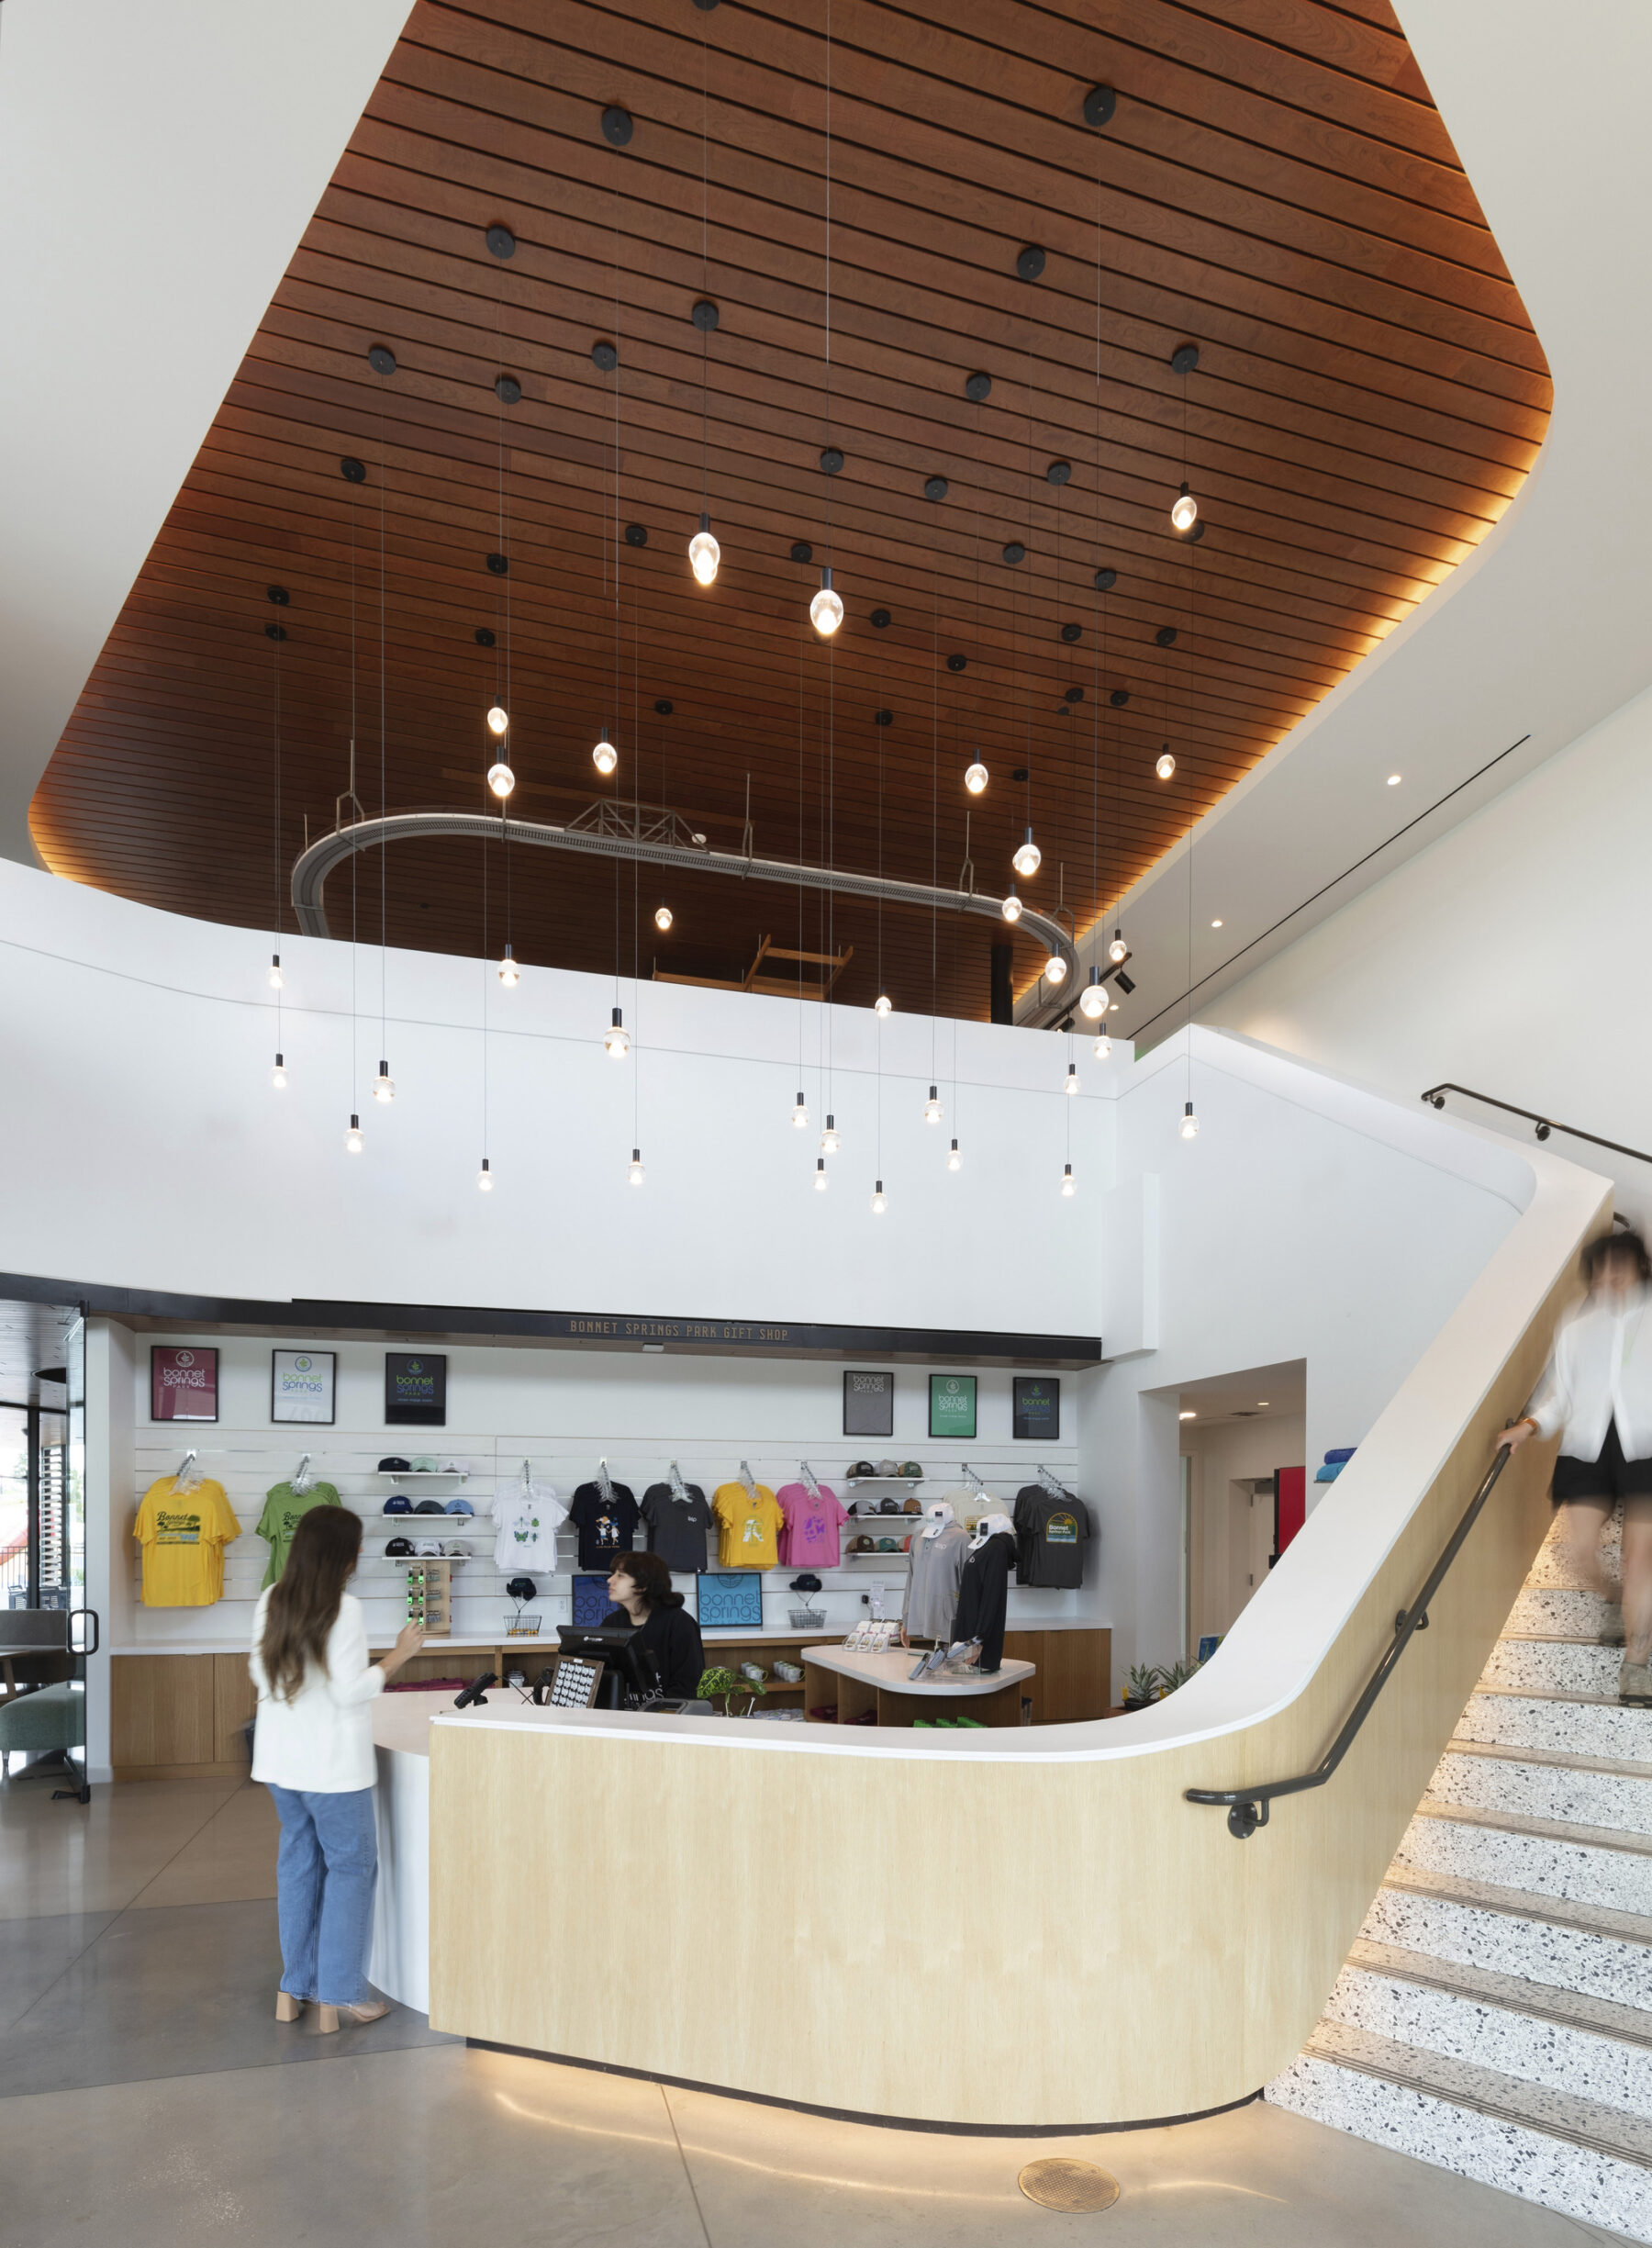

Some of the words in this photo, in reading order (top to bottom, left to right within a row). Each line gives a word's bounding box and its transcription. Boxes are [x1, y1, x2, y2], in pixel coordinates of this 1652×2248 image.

[570, 1320, 618, 1334] BONNET
[625, 1323, 679, 1336] SPRINGS
[686, 1325, 717, 1337] PARK
[723, 1326, 753, 1339] GIFT
[759, 1328, 788, 1340] SHOP
[163, 1367, 205, 1378] bonnet
[283, 1373, 322, 1382] bonnet
[163, 1376, 205, 1387] springs
[396, 1375, 433, 1385] bonnet
[853, 1374, 884, 1383] bonnet
[283, 1381, 323, 1392] springs
[938, 1394, 967, 1404] bonnet
[156, 1511, 188, 1521] Bonnet
[700, 1589, 761, 1606] bonnet
[700, 1605, 761, 1623] springs
